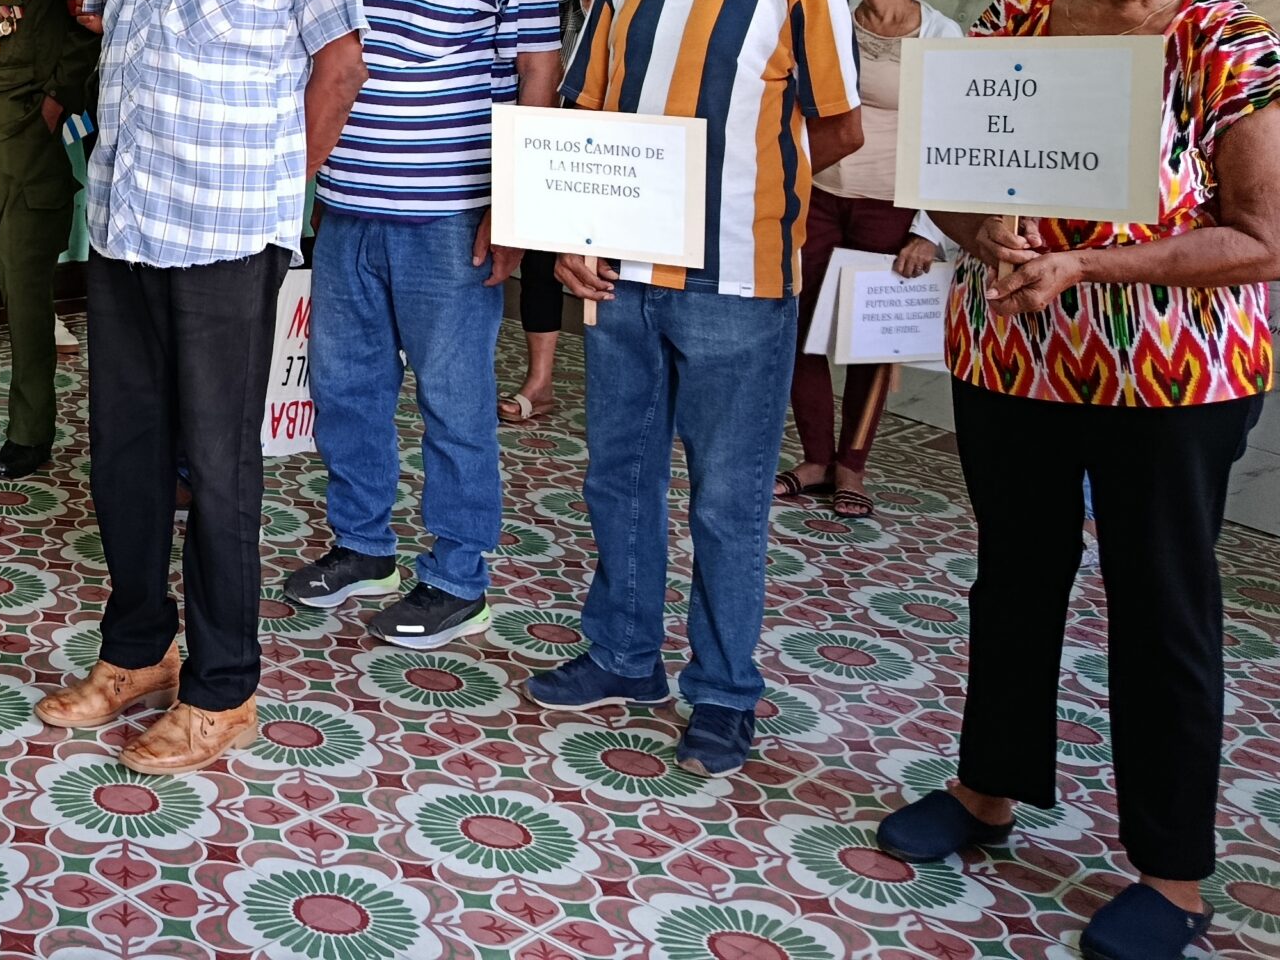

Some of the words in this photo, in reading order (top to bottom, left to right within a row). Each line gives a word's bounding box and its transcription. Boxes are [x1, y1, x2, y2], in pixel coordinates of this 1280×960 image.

[965, 79, 1037, 101] ABAJO
[987, 115, 1015, 134] EL
[524, 137, 551, 151] POR
[556, 140, 581, 153] LOS
[584, 142, 641, 158] CAMINO
[645, 147, 664, 160] DE
[926, 147, 1099, 171] IMPERIALISMO
[549, 160, 566, 172] LA
[571, 162, 637, 178] HISTORIA
[545, 178, 641, 198] VENCEREMOS
[867, 283, 927, 295] DEFENDAMOS
[929, 283, 940, 292] EL
[905, 297, 940, 307] SEAMOS
[862, 313, 892, 322] FIELES
[894, 312, 904, 321] AL
[906, 310, 942, 321] LEGADO
[881, 326, 893, 335] DE
[271, 400, 315, 439] UBA
